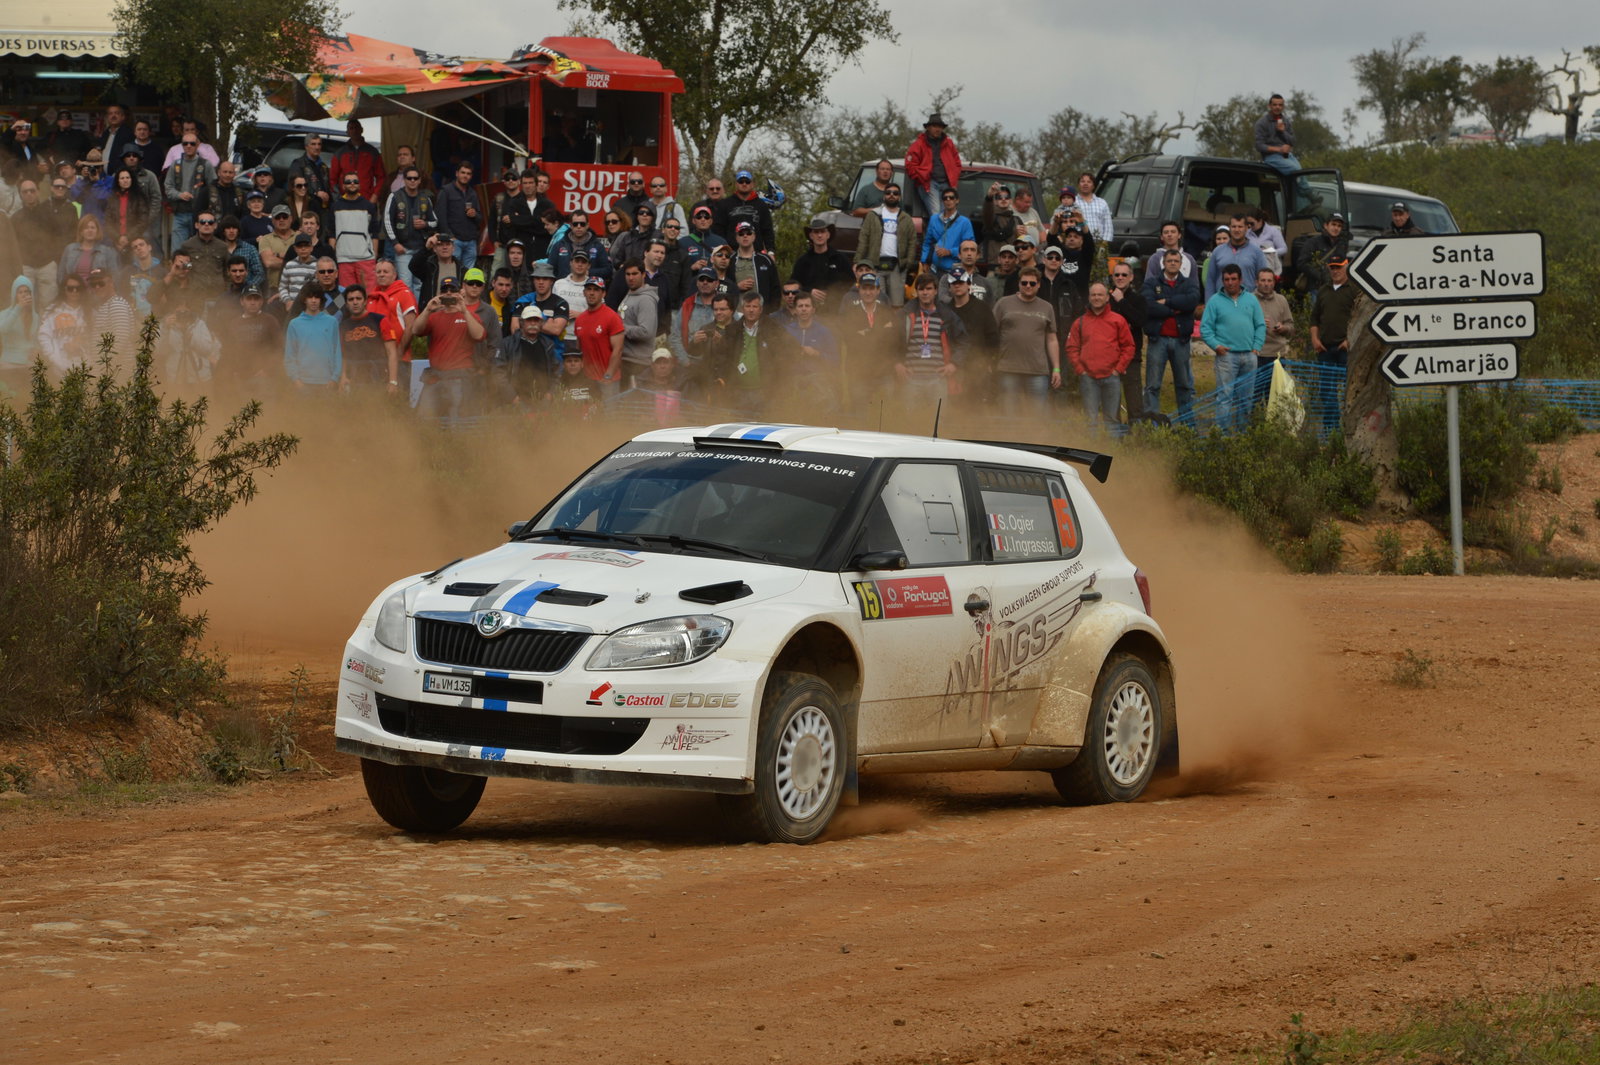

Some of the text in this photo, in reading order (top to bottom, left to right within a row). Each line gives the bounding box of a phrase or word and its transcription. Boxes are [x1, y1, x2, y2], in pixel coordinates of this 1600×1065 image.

[27, 39, 95, 50] DIVERSAS
[586, 72, 609, 81] SUPER
[586, 80, 608, 88] BOCK
[562, 169, 631, 192] SUPE
[564, 191, 627, 214] BOC
[1432, 245, 1494, 263] Santa
[1392, 269, 1534, 290] Clara-a-Nova
[1453, 313, 1526, 330] Branco
[1414, 353, 1509, 375] Almarjão
[610, 451, 856, 477] VOLKSWAGEN GROUP SUPPORTS WINGS FOR LIFE
[1053, 498, 1077, 550] 15
[904, 589, 949, 603] Portugal
[999, 560, 1084, 619] VOLKSWAGEN GROUP SUPPORTS
[856, 582, 880, 618] 15
[625, 692, 741, 708] Castrol EDGE
[668, 734, 704, 744] WINGS
[672, 742, 693, 751] LIFE
